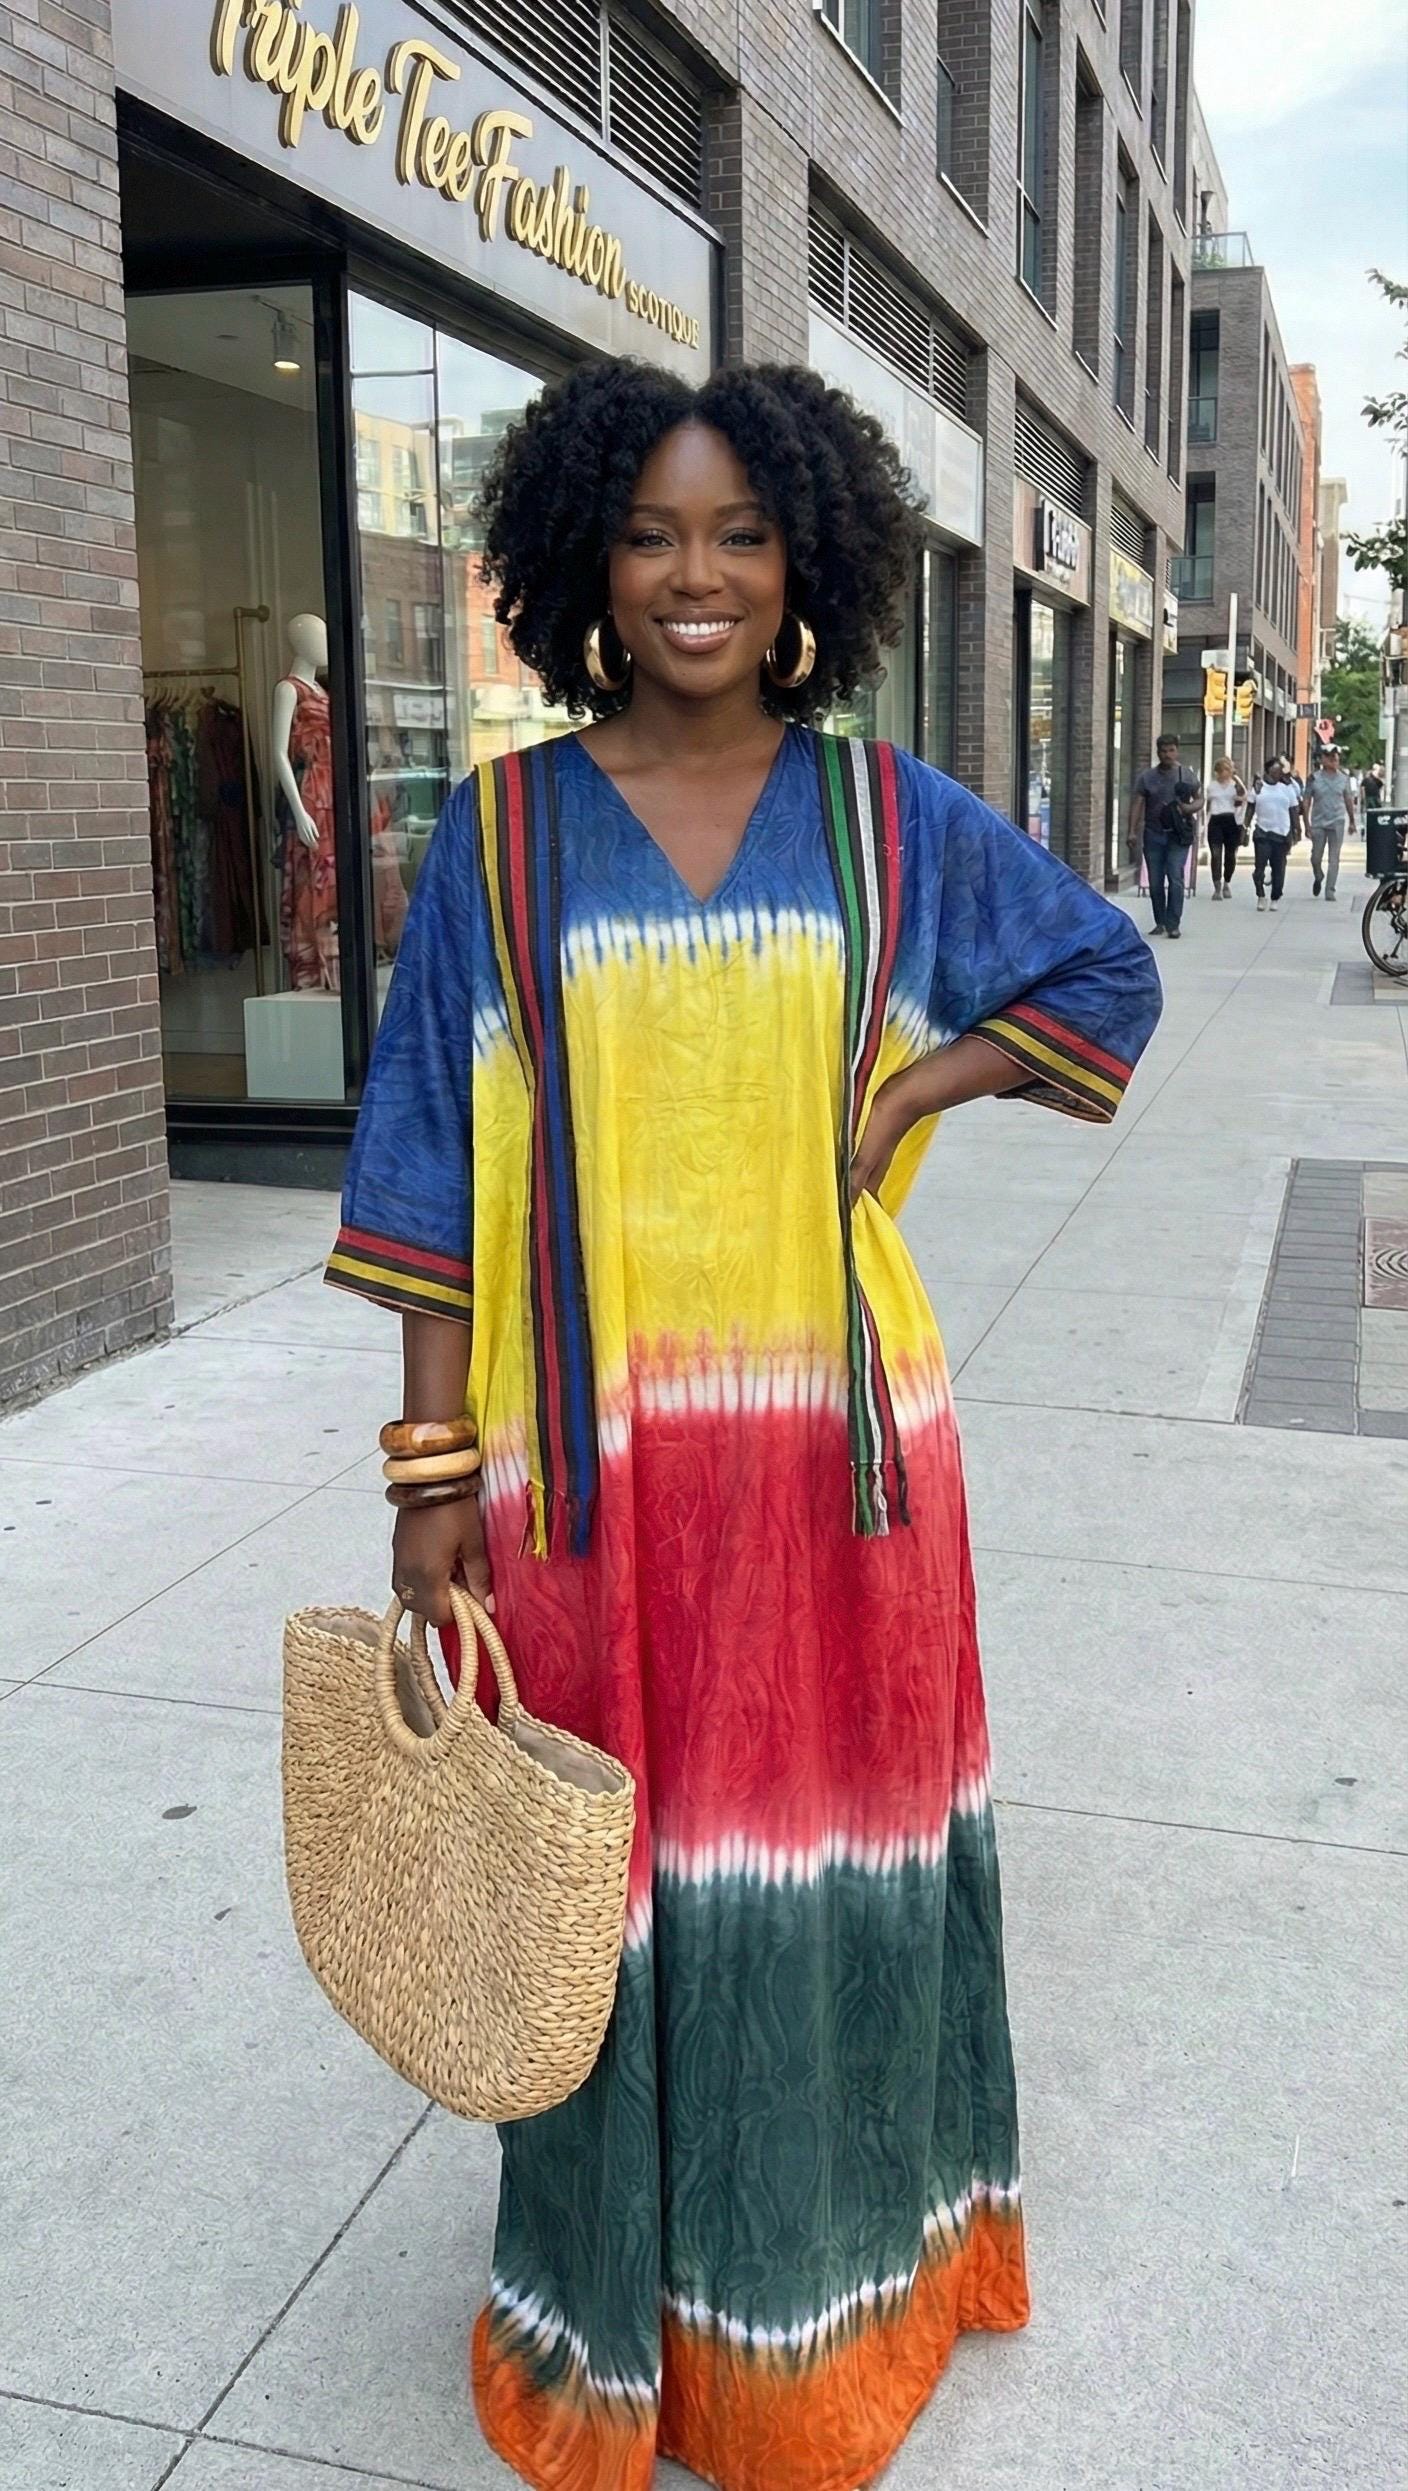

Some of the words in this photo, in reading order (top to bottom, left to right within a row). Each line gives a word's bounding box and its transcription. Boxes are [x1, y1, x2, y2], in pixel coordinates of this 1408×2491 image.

[386, 39, 474, 202] Tee
[472, 110, 626, 298] Fashion
[627, 280, 700, 349] SCOTIQUE
